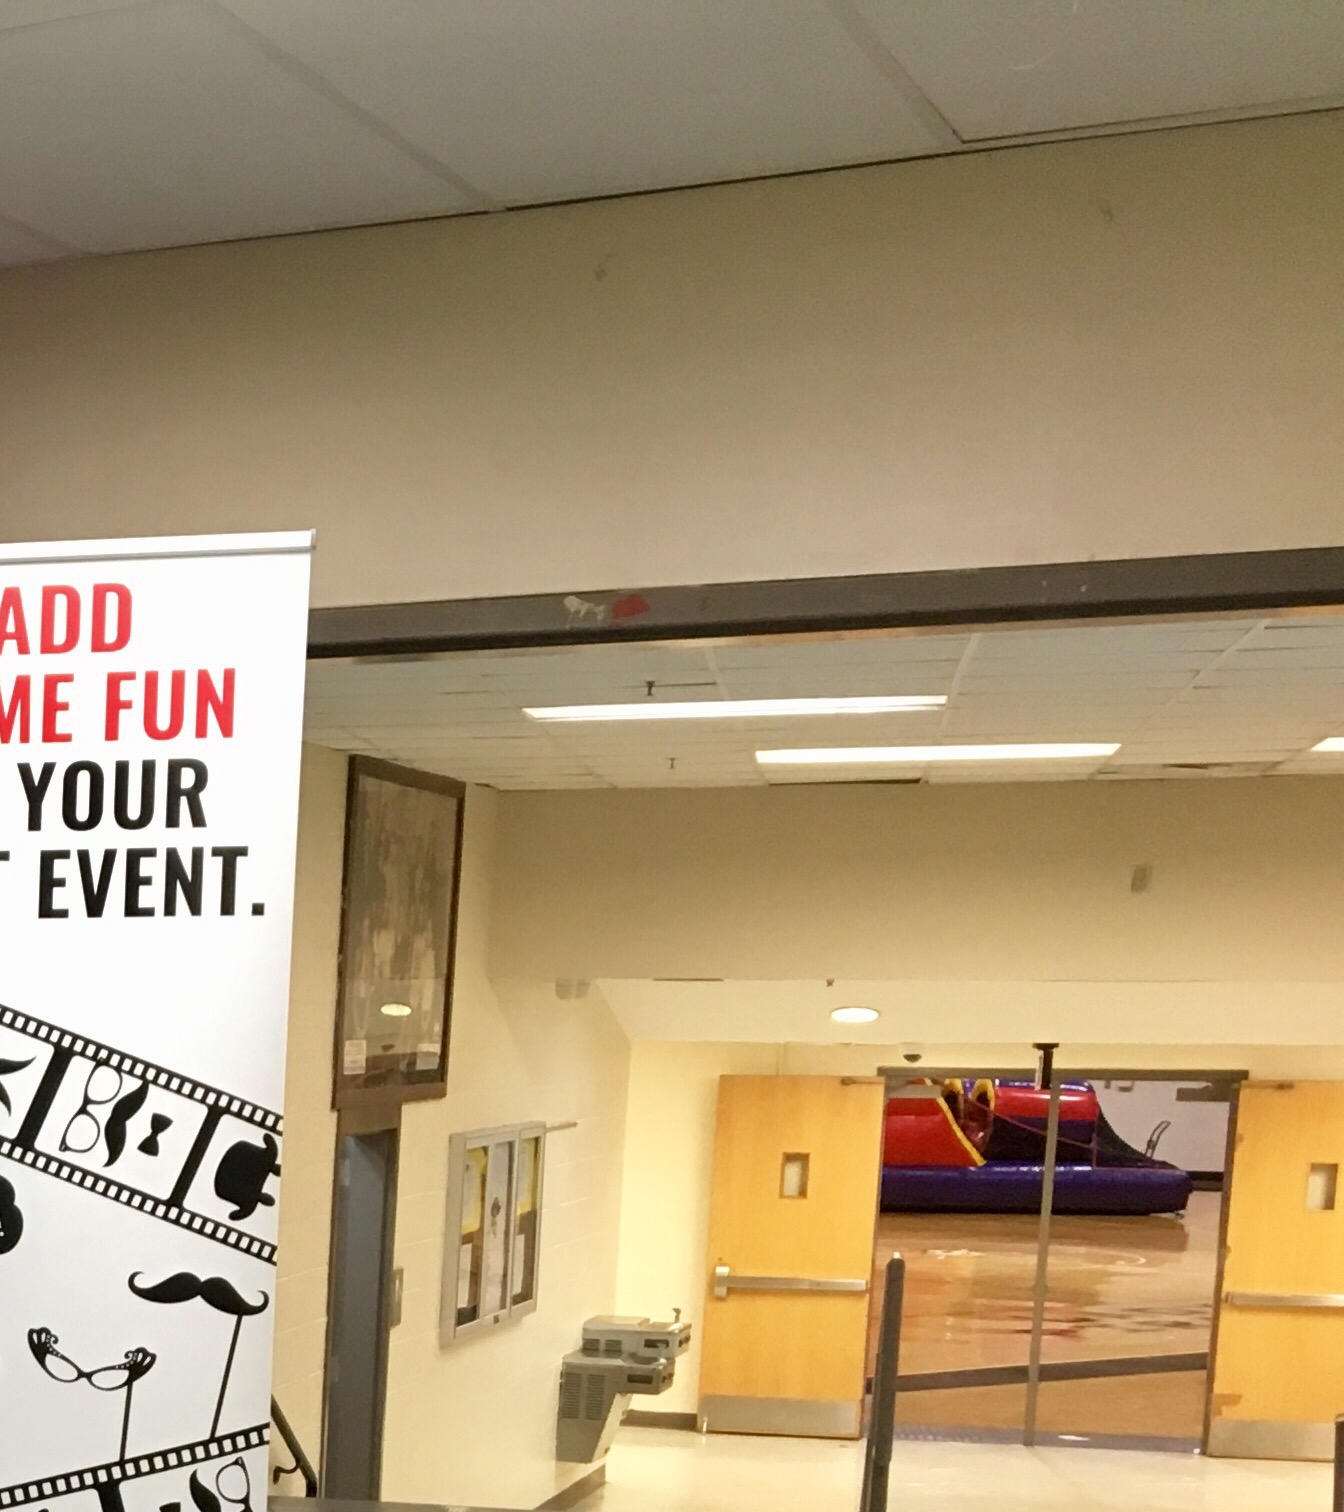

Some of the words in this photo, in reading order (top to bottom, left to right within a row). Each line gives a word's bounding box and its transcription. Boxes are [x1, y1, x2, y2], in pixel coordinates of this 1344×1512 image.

[105, 668, 236, 741] FUN
[18, 758, 208, 832] YOUR
[38, 846, 266, 919] EVENT.
